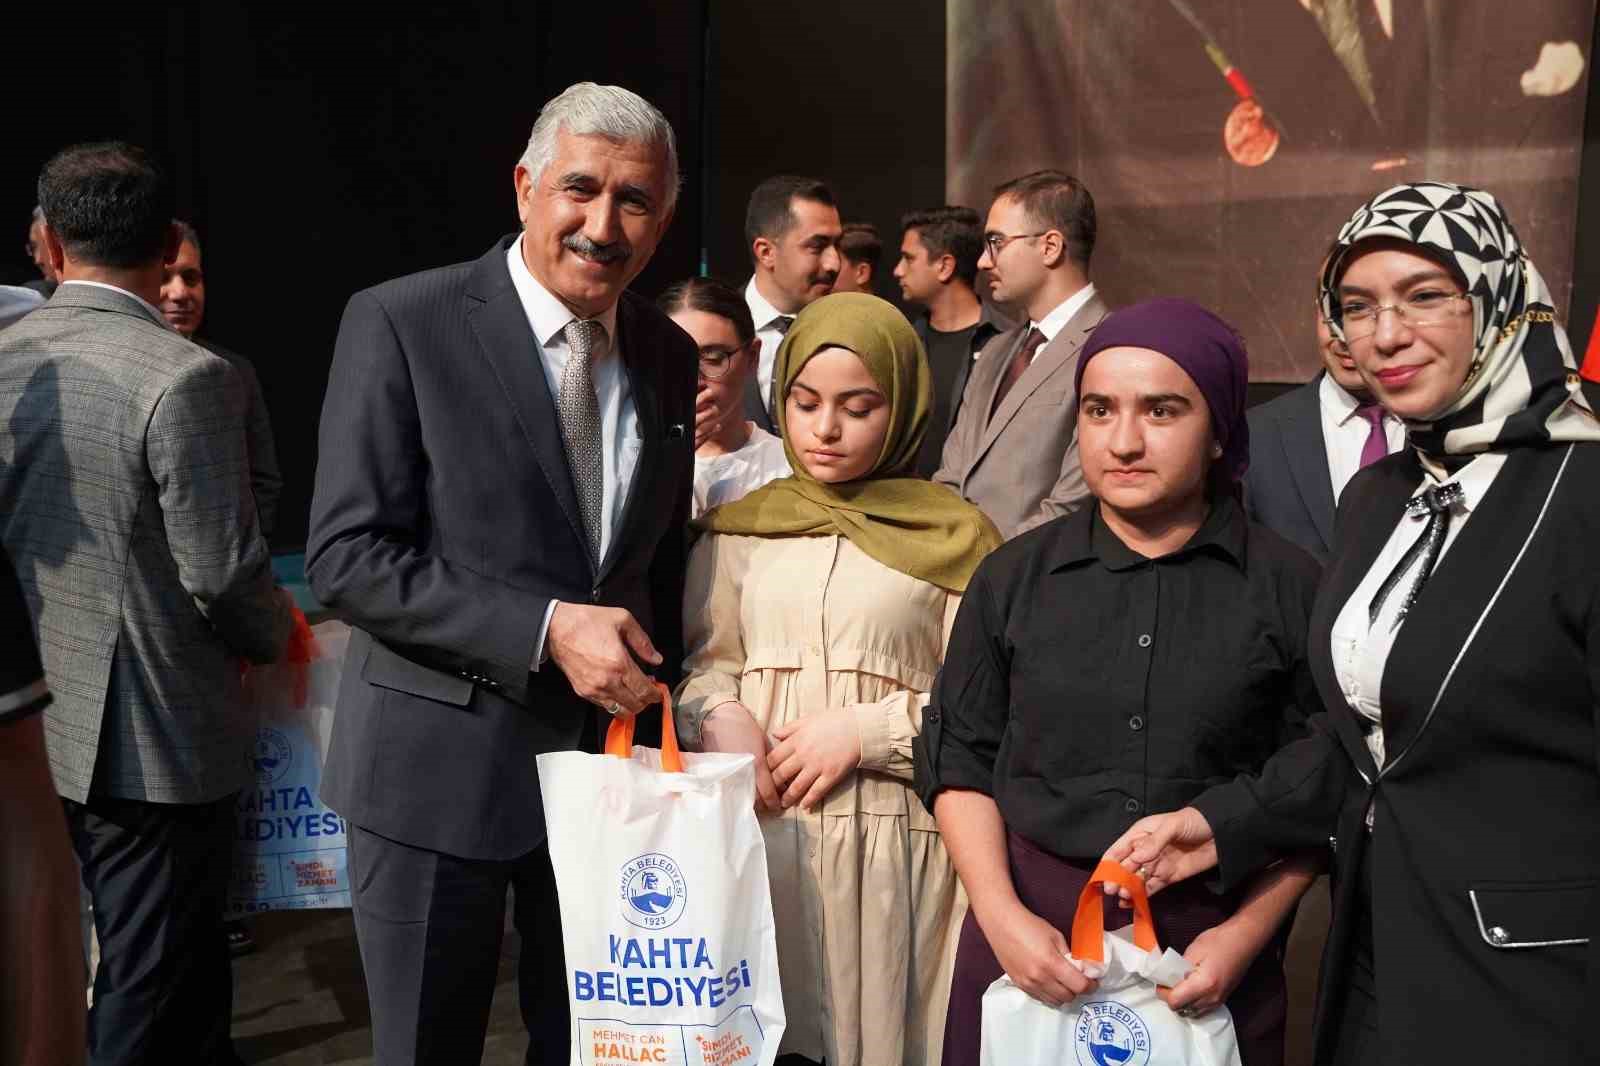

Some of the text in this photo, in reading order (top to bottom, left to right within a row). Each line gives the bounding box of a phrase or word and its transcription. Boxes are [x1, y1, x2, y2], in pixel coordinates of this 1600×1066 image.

[643, 916, 667, 926] 1923
[608, 934, 714, 970] KAHTA
[593, 1030, 665, 1044] MEHMET CAN
